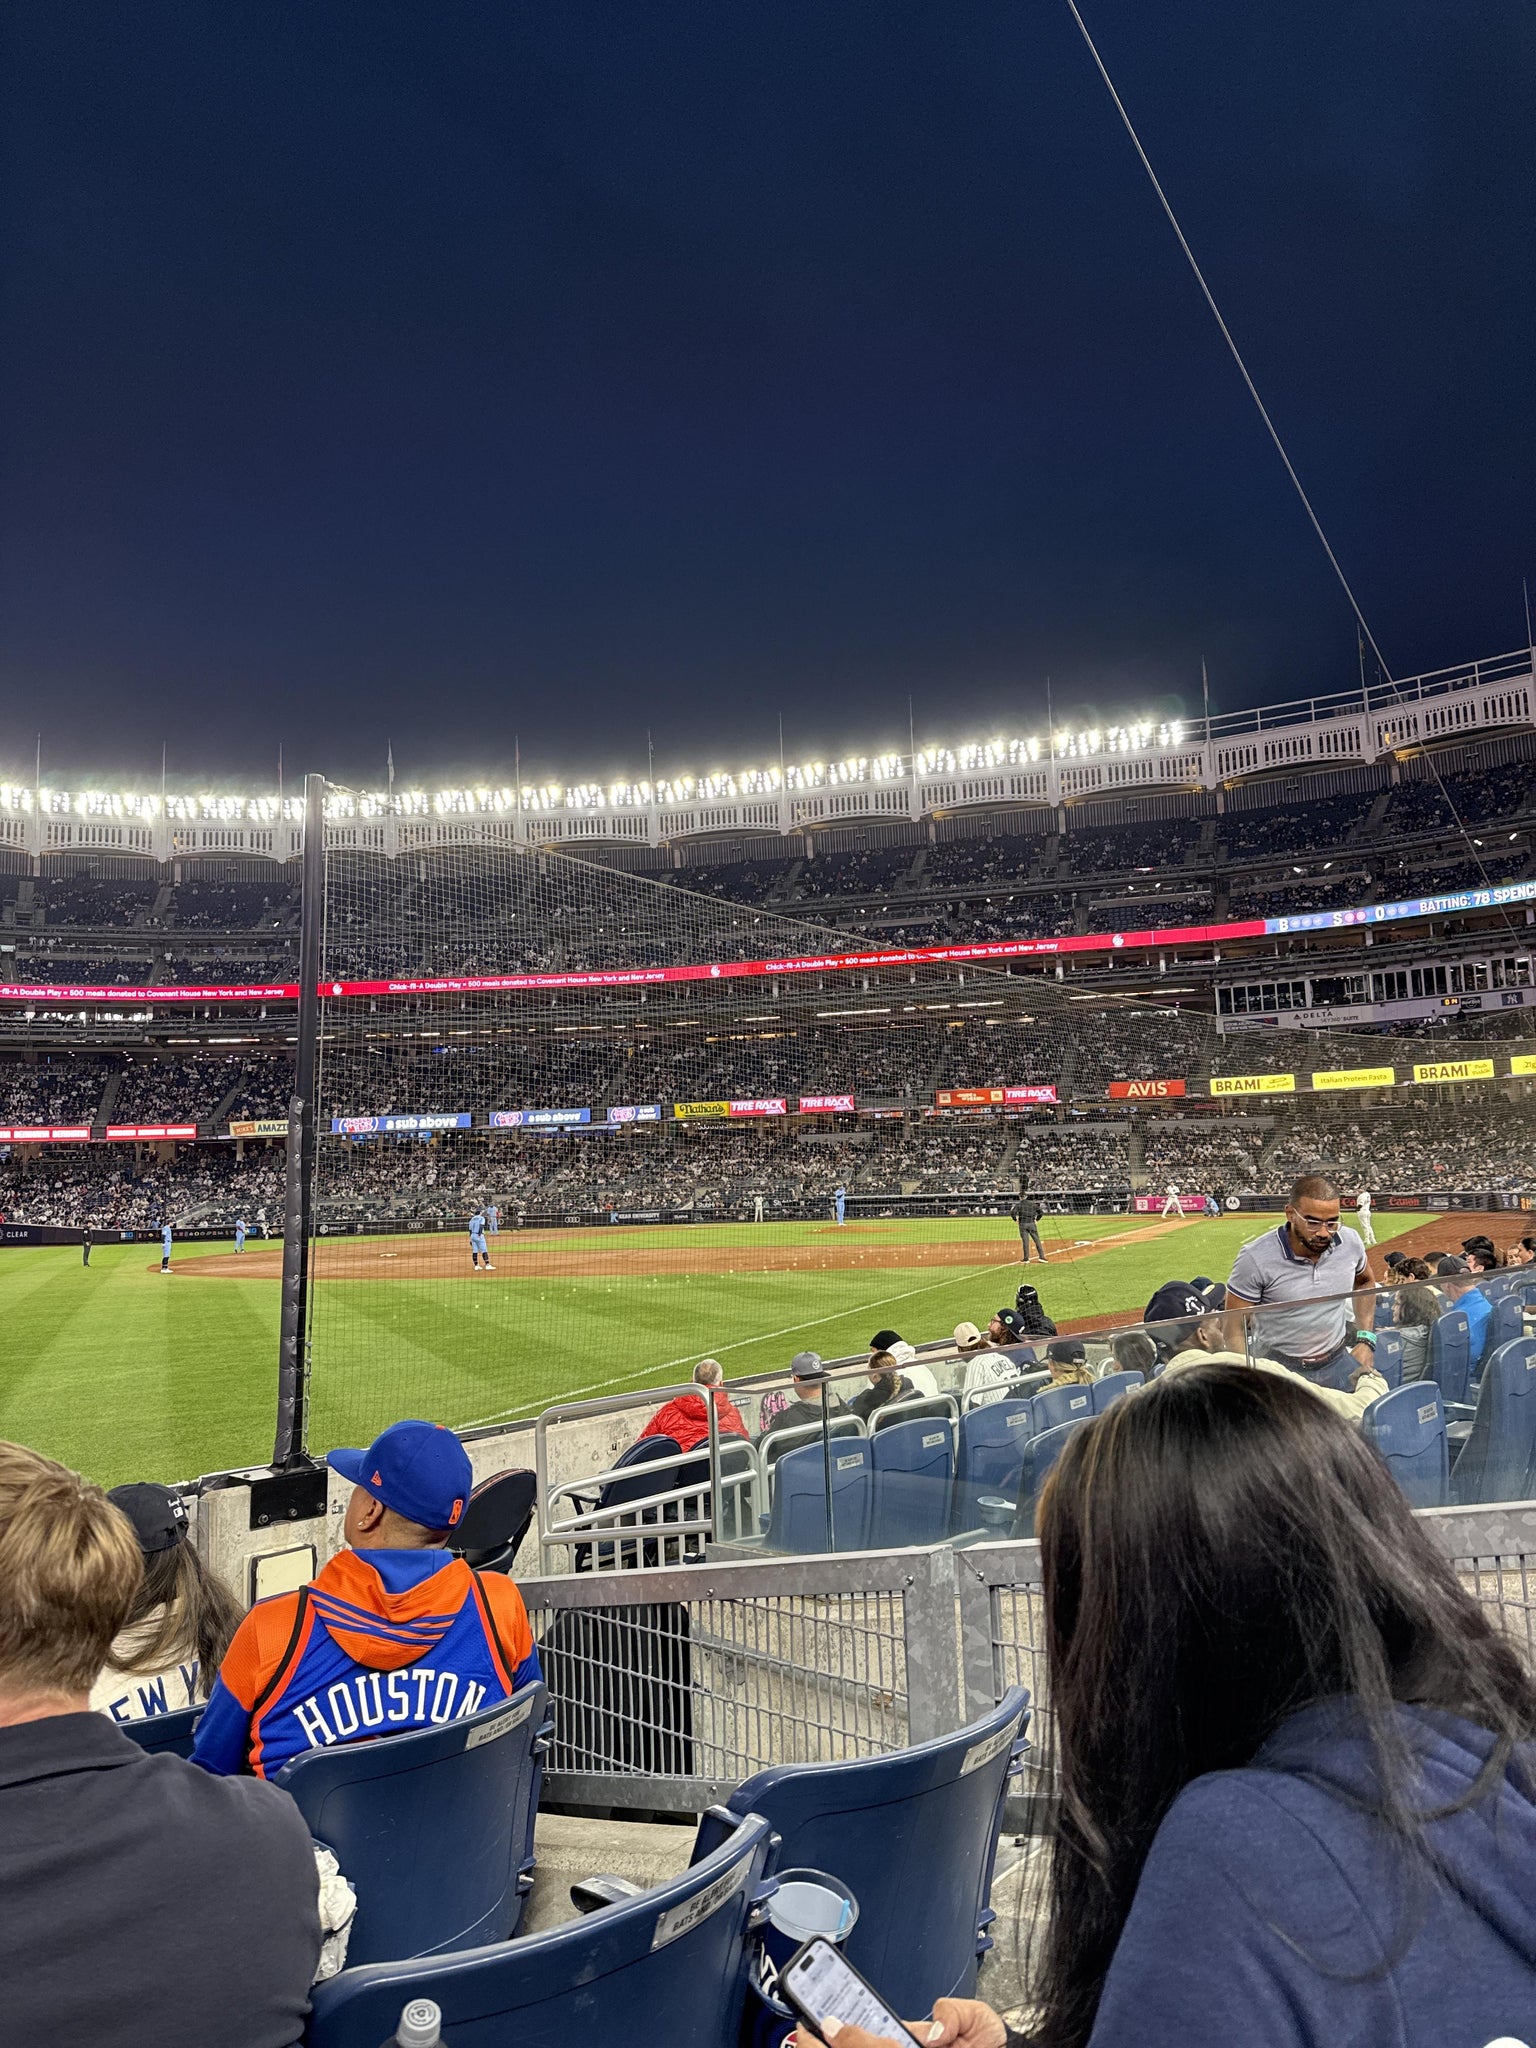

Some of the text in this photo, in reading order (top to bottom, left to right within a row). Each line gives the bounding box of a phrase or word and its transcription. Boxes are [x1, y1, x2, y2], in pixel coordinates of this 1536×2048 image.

[1279, 919, 1288, 932] B
[1333, 912, 1342, 925] S
[1420, 896, 1472, 913] BATTING:
[1473, 892, 1490, 905] 78
[1493, 884, 1536, 902] SPENC
[801, 960, 825, 969] Double
[825, 959, 839, 968] Play
[879, 954, 907, 963] donated
[949, 949, 970, 957] House
[971, 948, 987, 956] New
[988, 946, 1003, 955] York
[1004, 945, 1018, 953] and
[1019, 944, 1034, 952] New
[1035, 942, 1058, 951] Jersey
[425, 981, 447, 989] Double
[448, 981, 462, 990] Play
[468, 980, 481, 988] 500
[501, 979, 528, 987] donated
[536, 977, 567, 985] Covenant
[568, 976, 587, 984] House
[603, 974, 618, 983] York
[631, 973, 644, 981] New
[645, 972, 665, 981] Jersey
[47, 989, 62, 998] Play
[107, 990, 137, 998] donated
[146, 990, 179, 998] Covenant
[219, 989, 234, 997] York
[263, 988, 285, 997] Jersey
[1303, 1011, 1333, 1020] DELTA
[1320, 1073, 1387, 1084] Italian Protein Pasta
[1419, 1065, 1468, 1080] BRAMI
[1127, 1081, 1168, 1097] AVIS
[1216, 1079, 1261, 1092] BRAMI
[1006, 1088, 1056, 1100] TIRE RACK
[680, 1103, 725, 1115] Nathan's
[731, 1099, 784, 1113] TIRE RACK
[801, 1096, 853, 1110] TIRE RACK
[386, 1116, 458, 1130] a sub above
[535, 1112, 551, 1122] sub
[552, 1111, 581, 1121] above
[1388, 1197, 1420, 1207] Canon
[292, 1668, 487, 1748] HOUSTON
[689, 1900, 701, 1913] BE
[672, 1913, 695, 1933] BATS
